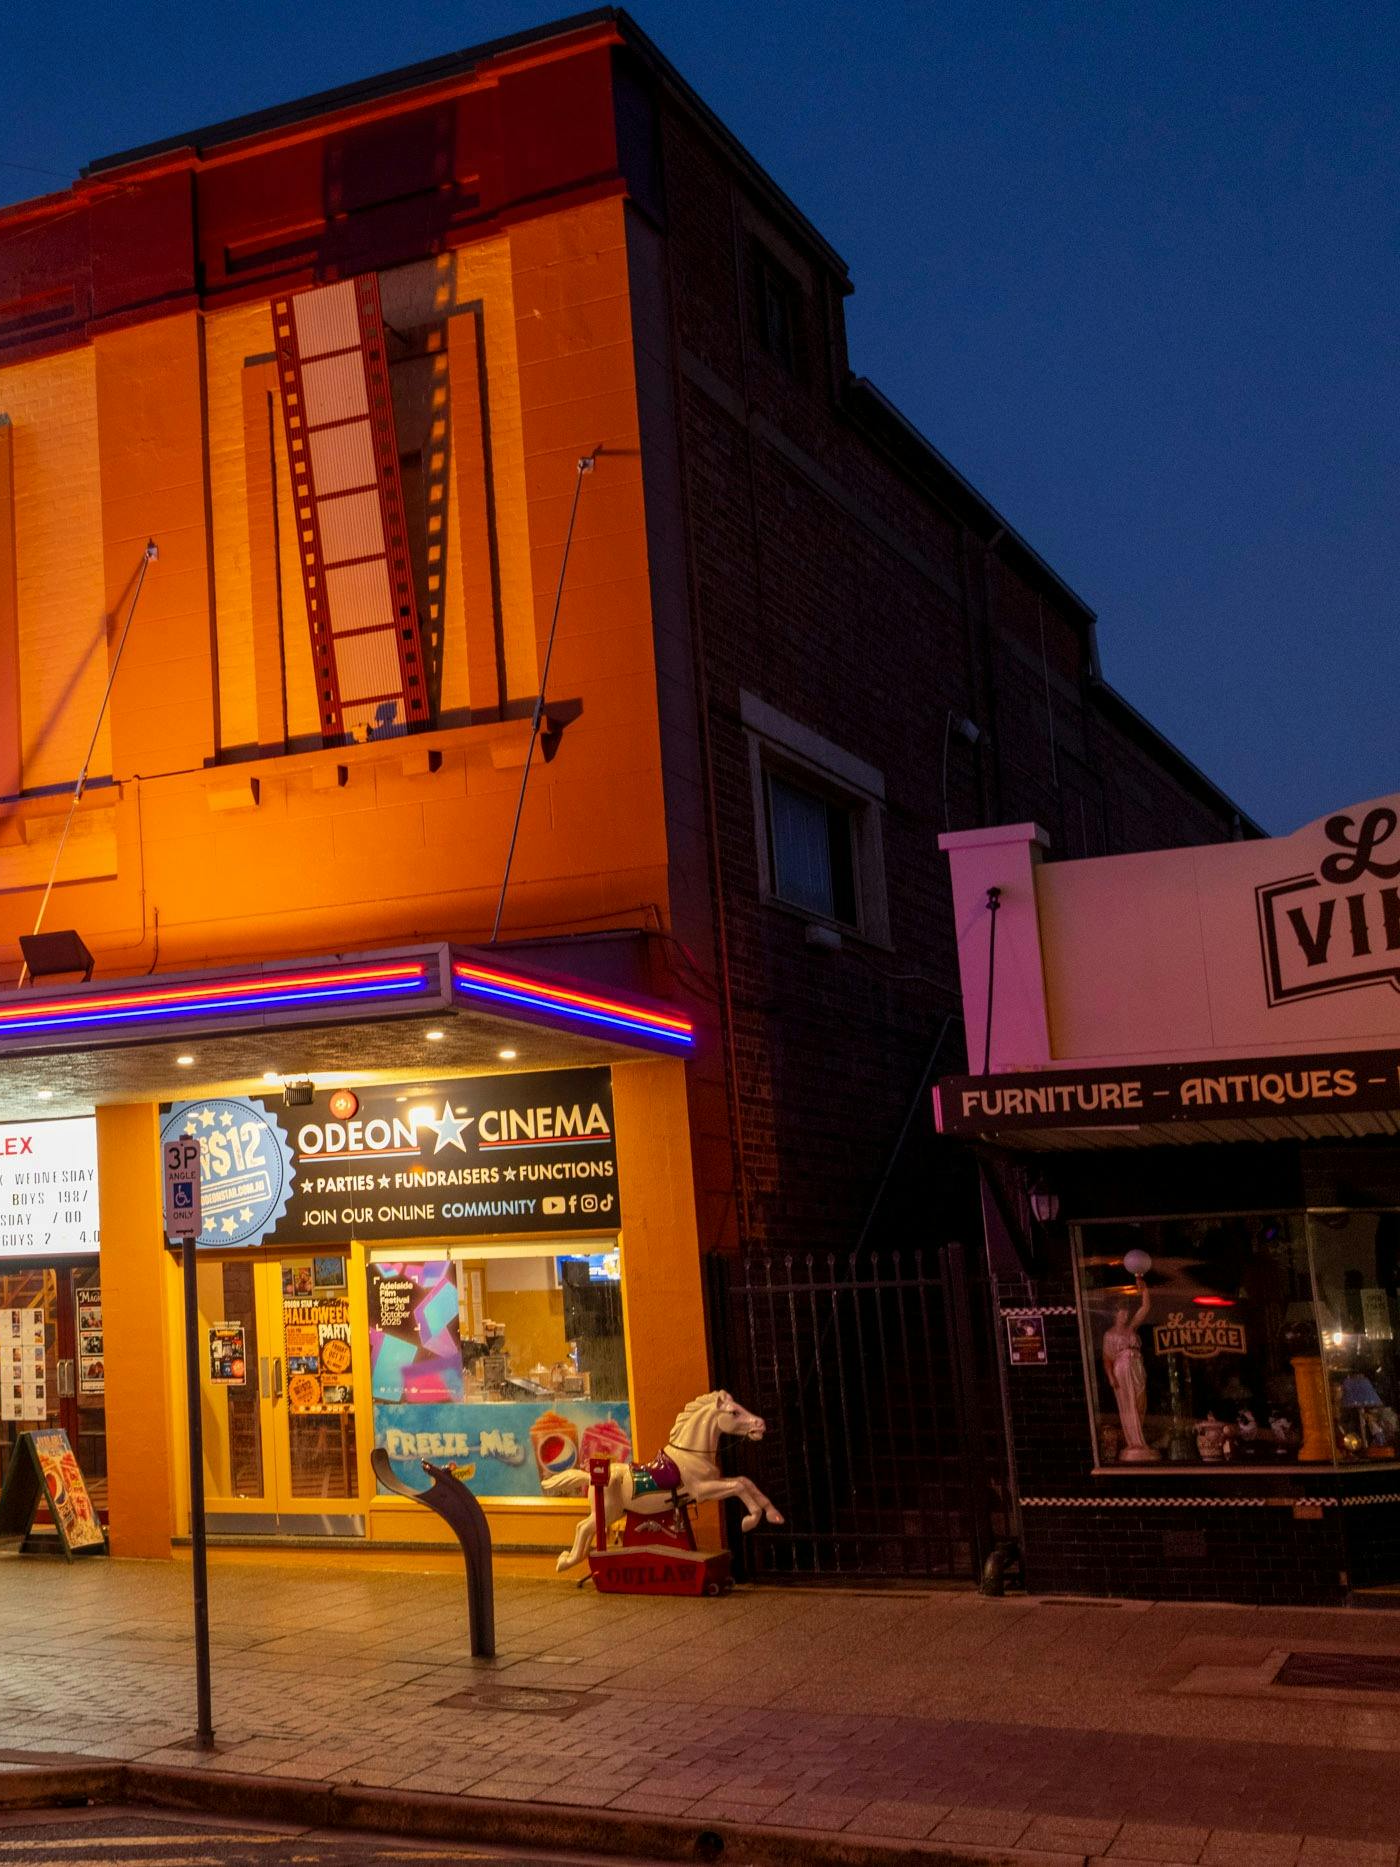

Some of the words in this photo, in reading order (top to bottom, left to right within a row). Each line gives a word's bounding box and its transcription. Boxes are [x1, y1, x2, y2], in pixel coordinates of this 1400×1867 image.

[962, 1081, 1143, 1117] FURNITURE
[1180, 1069, 1357, 1106] ANTIQUES
[299, 1117, 419, 1155] ODEON
[478, 1102, 610, 1143] CINEMA
[168, 1146, 198, 1170] 3P
[208, 1121, 266, 1177] $12
[15, 1169, 94, 1185] WEDNESDAY
[169, 1171, 197, 1180] ANGLE
[316, 1174, 375, 1192] PARTIES
[395, 1167, 500, 1189] FUNDRAISERS
[519, 1160, 614, 1181] FUNCTIONS
[12, 1192, 45, 1206] BOYS
[58, 1190, 88, 1203] 1987
[173, 1212, 194, 1221] ONLY
[302, 1206, 338, 1226] JOIN
[341, 1205, 374, 1224] OUR
[377, 1203, 435, 1222] ONLINE
[441, 1198, 537, 1220] COMMUNITY
[2, 1233, 34, 1247] GUYS
[379, 1282, 413, 1290] Adelaide
[380, 1289, 396, 1297] Film
[380, 1296, 410, 1304] Festival
[285, 1306, 351, 1324] HALLOWEEN
[381, 1311, 410, 1319] October
[319, 1323, 351, 1347] PARTY
[1160, 1328, 1240, 1347] VINTAGE
[386, 1428, 469, 1458] FREEZE
